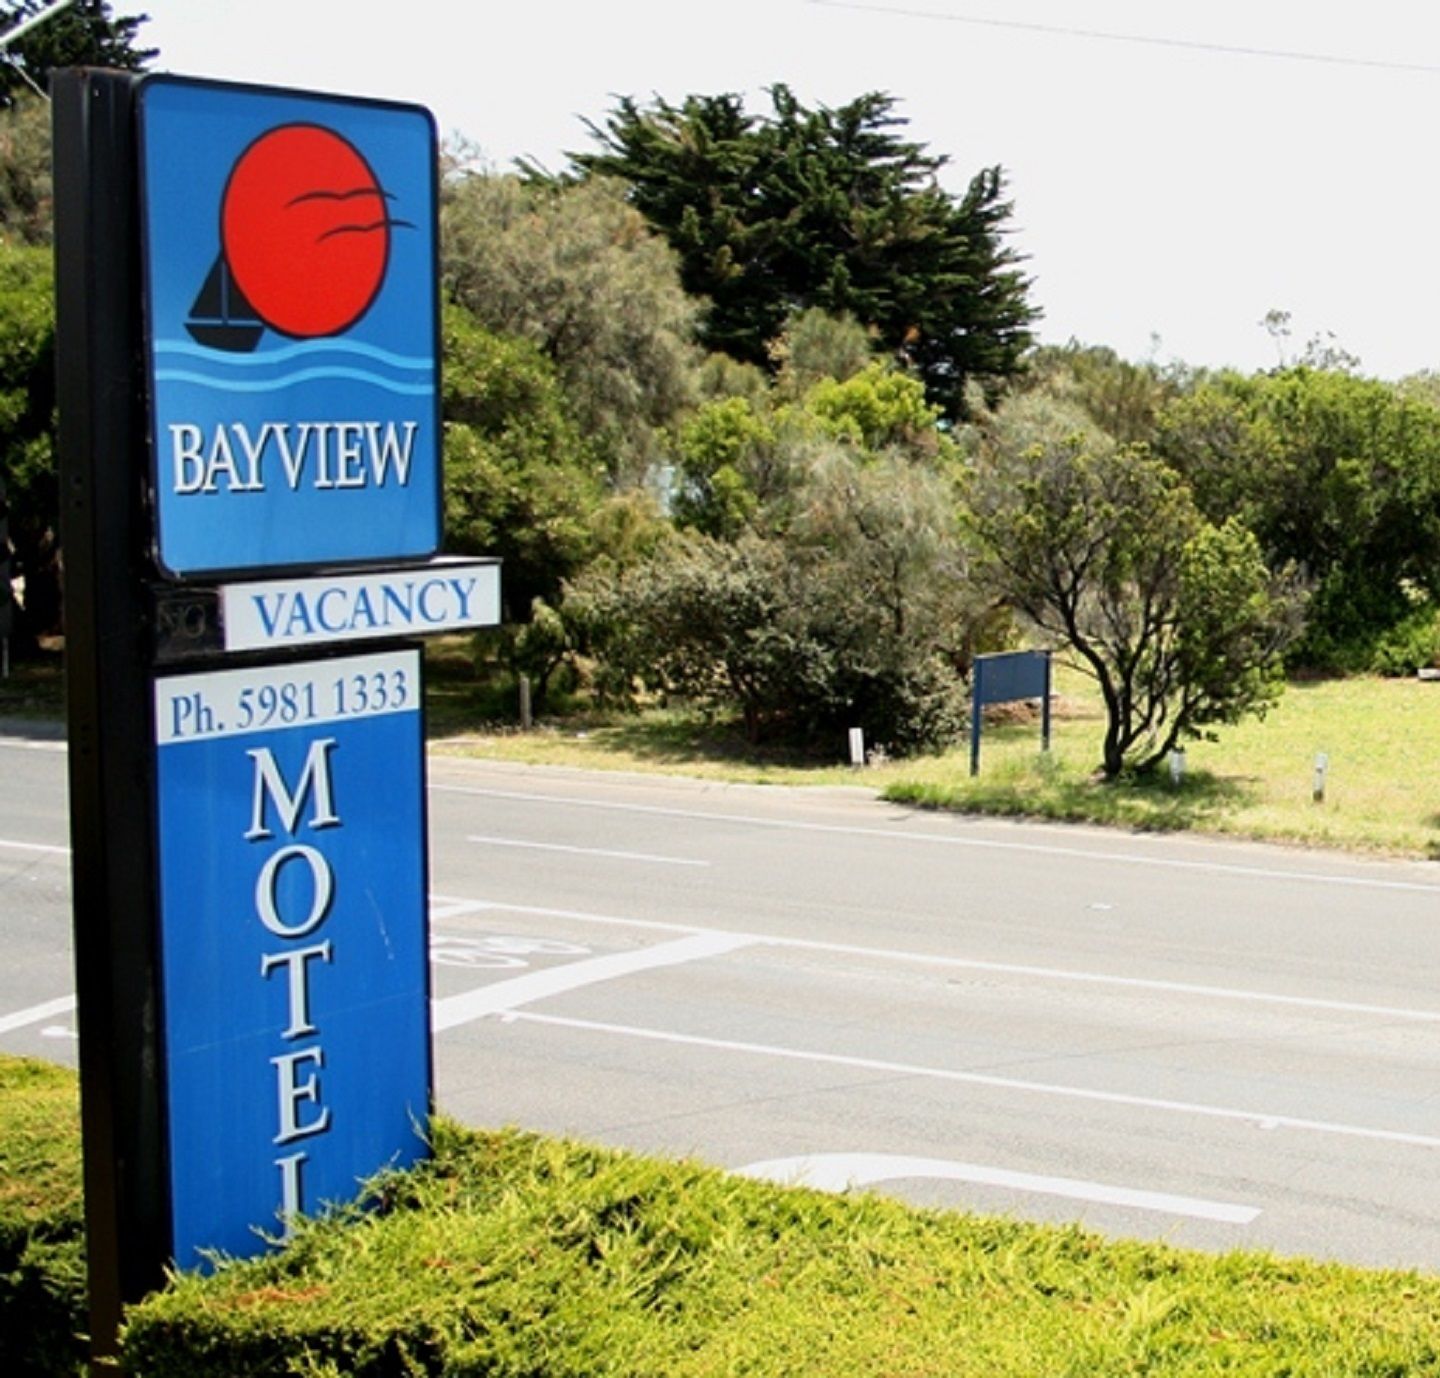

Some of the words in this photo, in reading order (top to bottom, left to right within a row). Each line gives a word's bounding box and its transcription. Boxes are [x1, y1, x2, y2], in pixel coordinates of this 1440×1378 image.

[168, 420, 418, 495] BAYVIEW
[251, 577, 478, 638] VACANCY
[170, 691, 225, 737] Ph.
[236, 681, 317, 729] 5981
[333, 670, 408, 715] 1333
